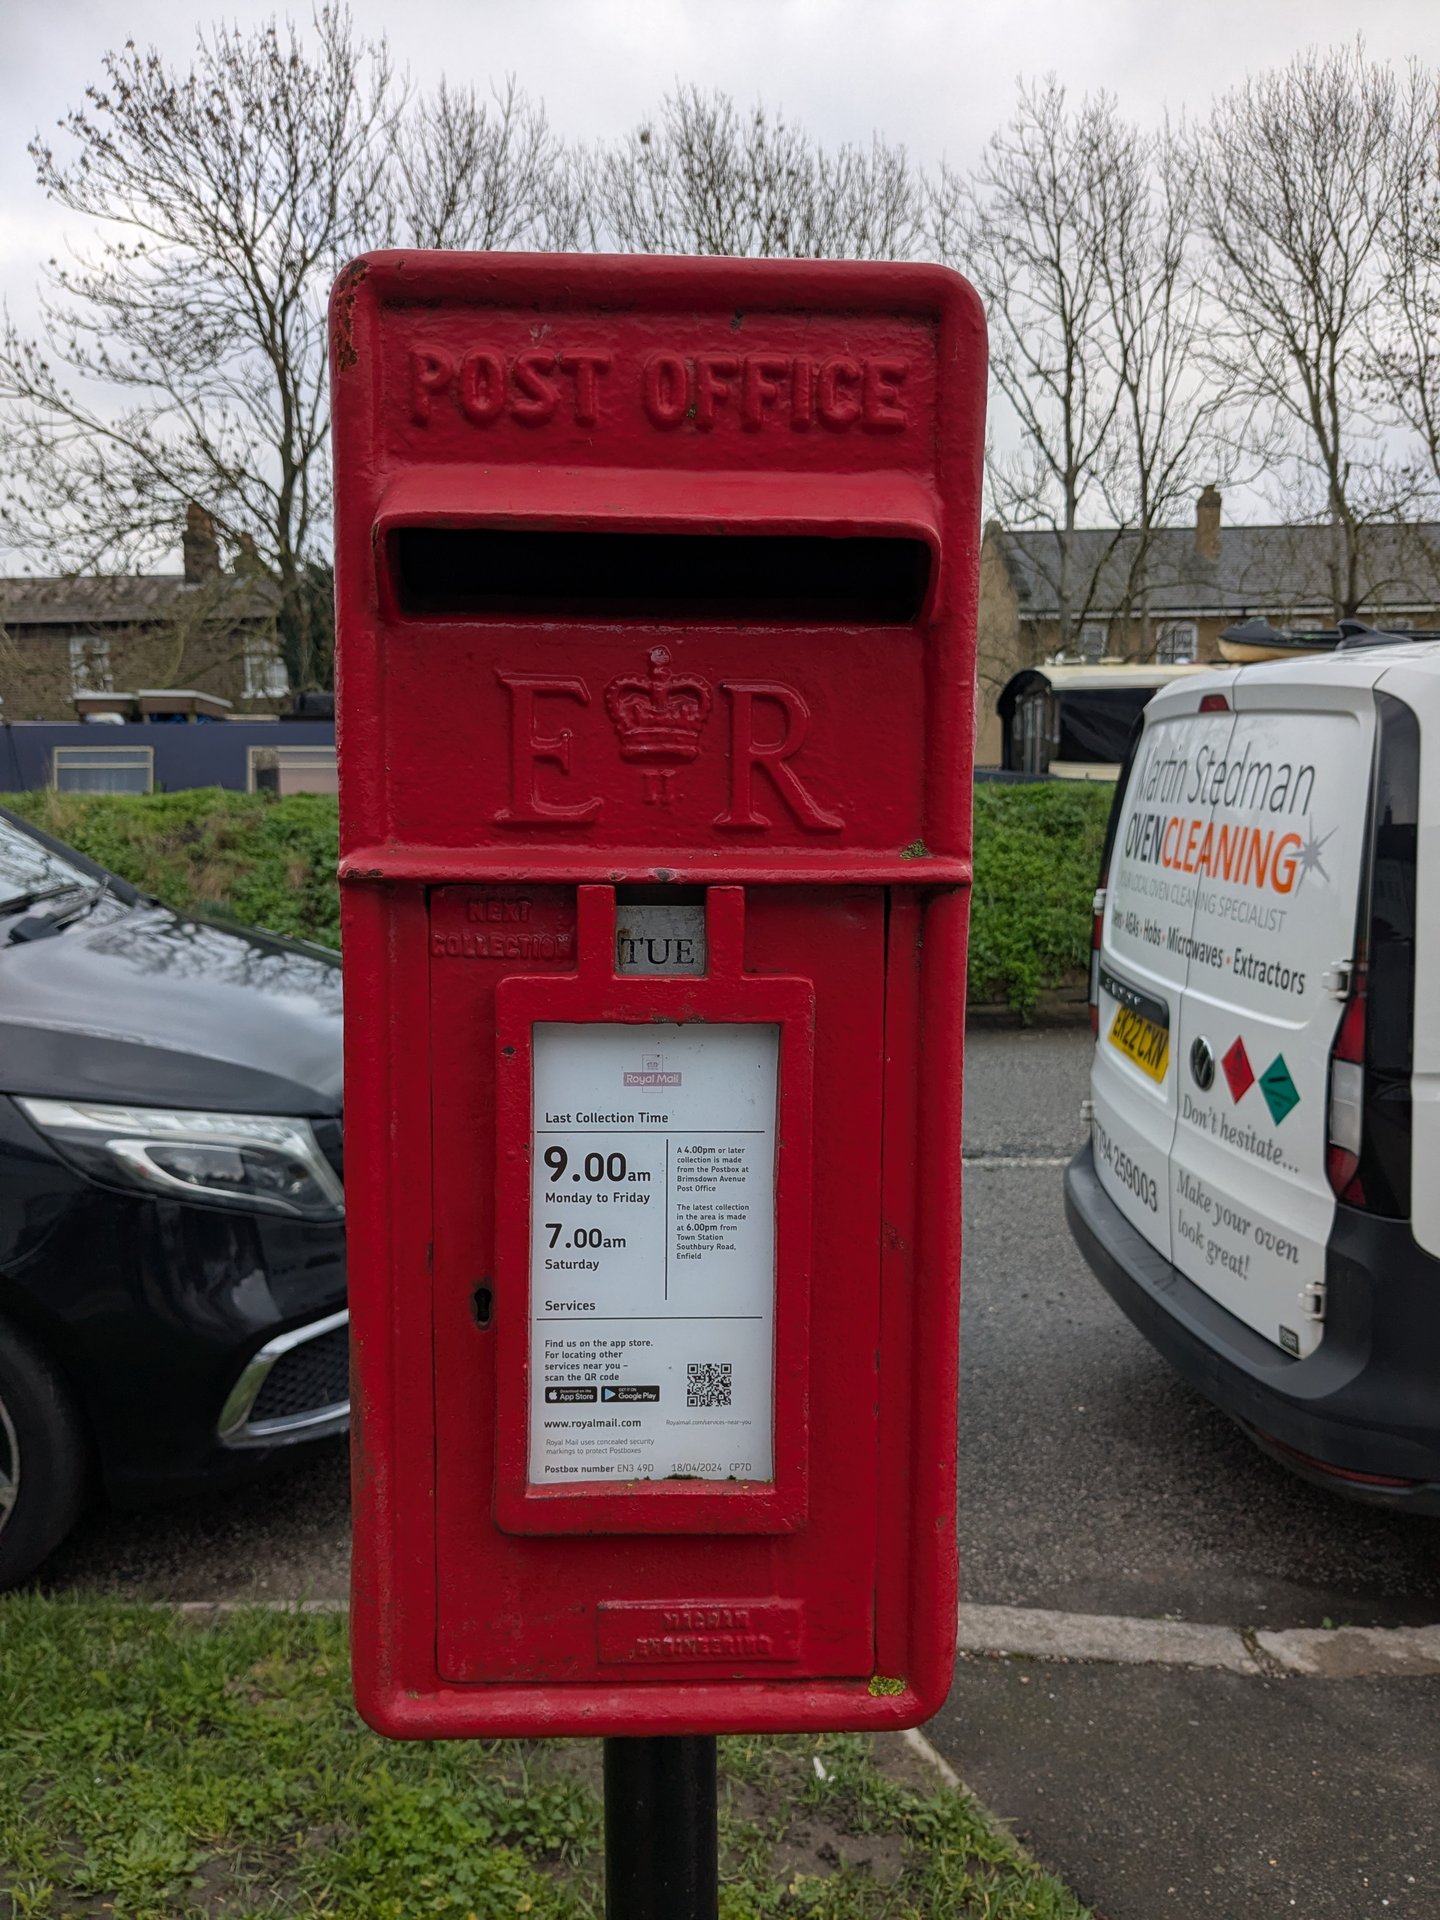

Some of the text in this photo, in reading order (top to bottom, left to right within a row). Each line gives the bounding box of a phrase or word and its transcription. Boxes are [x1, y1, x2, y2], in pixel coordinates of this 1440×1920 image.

[408, 344, 908, 432] POST OFFICE
[493, 667, 845, 834] E R
[1187, 740, 1316, 816] Stedman
[467, 900, 531, 923] NEXT
[1217, 896, 1287, 933] SPECIALIST
[431, 934, 574, 959] COLLECTION
[620, 937, 695, 965] TUE
[1143, 917, 1161, 947] Hobs
[1167, 925, 1223, 970] Microwaves
[1233, 947, 1306, 996] Extractors
[626, 1074, 679, 1085] Royal Mail
[546, 1112, 668, 1123] Last Collection Time
[1183, 1094, 1217, 1135] Don't
[1220, 1112, 1299, 1174] hesitate...
[685, 1146, 715, 1155] 4.00pm
[544, 1146, 651, 1182] 9.00am
[1113, 1145, 1157, 1213] 259003
[546, 1192, 650, 1205] Monday to Friday
[1176, 1170, 1299, 1264] Make your oven
[687, 1223, 717, 1232] 6.00pm
[545, 1223, 626, 1248] 7.00am
[677, 1243, 714, 1251] Southbury
[1177, 1208, 1250, 1280] look great!
[545, 1259, 599, 1271] Saturday
[545, 1300, 595, 1311] Services
[593, 1339, 607, 1347] the
[545, 1351, 559, 1359] For
[562, 1351, 596, 1359] locating
[545, 1362, 580, 1370] services
[585, 1373, 596, 1381] QR
[544, 1418, 641, 1429] www.royalmail.com
[546, 1439, 563, 1447] Royal
[545, 1465, 578, 1473] Postbox
[617, 1464, 633, 1472] EN3
[637, 1464, 654, 1472] 49D
[672, 1463, 751, 1472] 18/04/2024 CP7D
